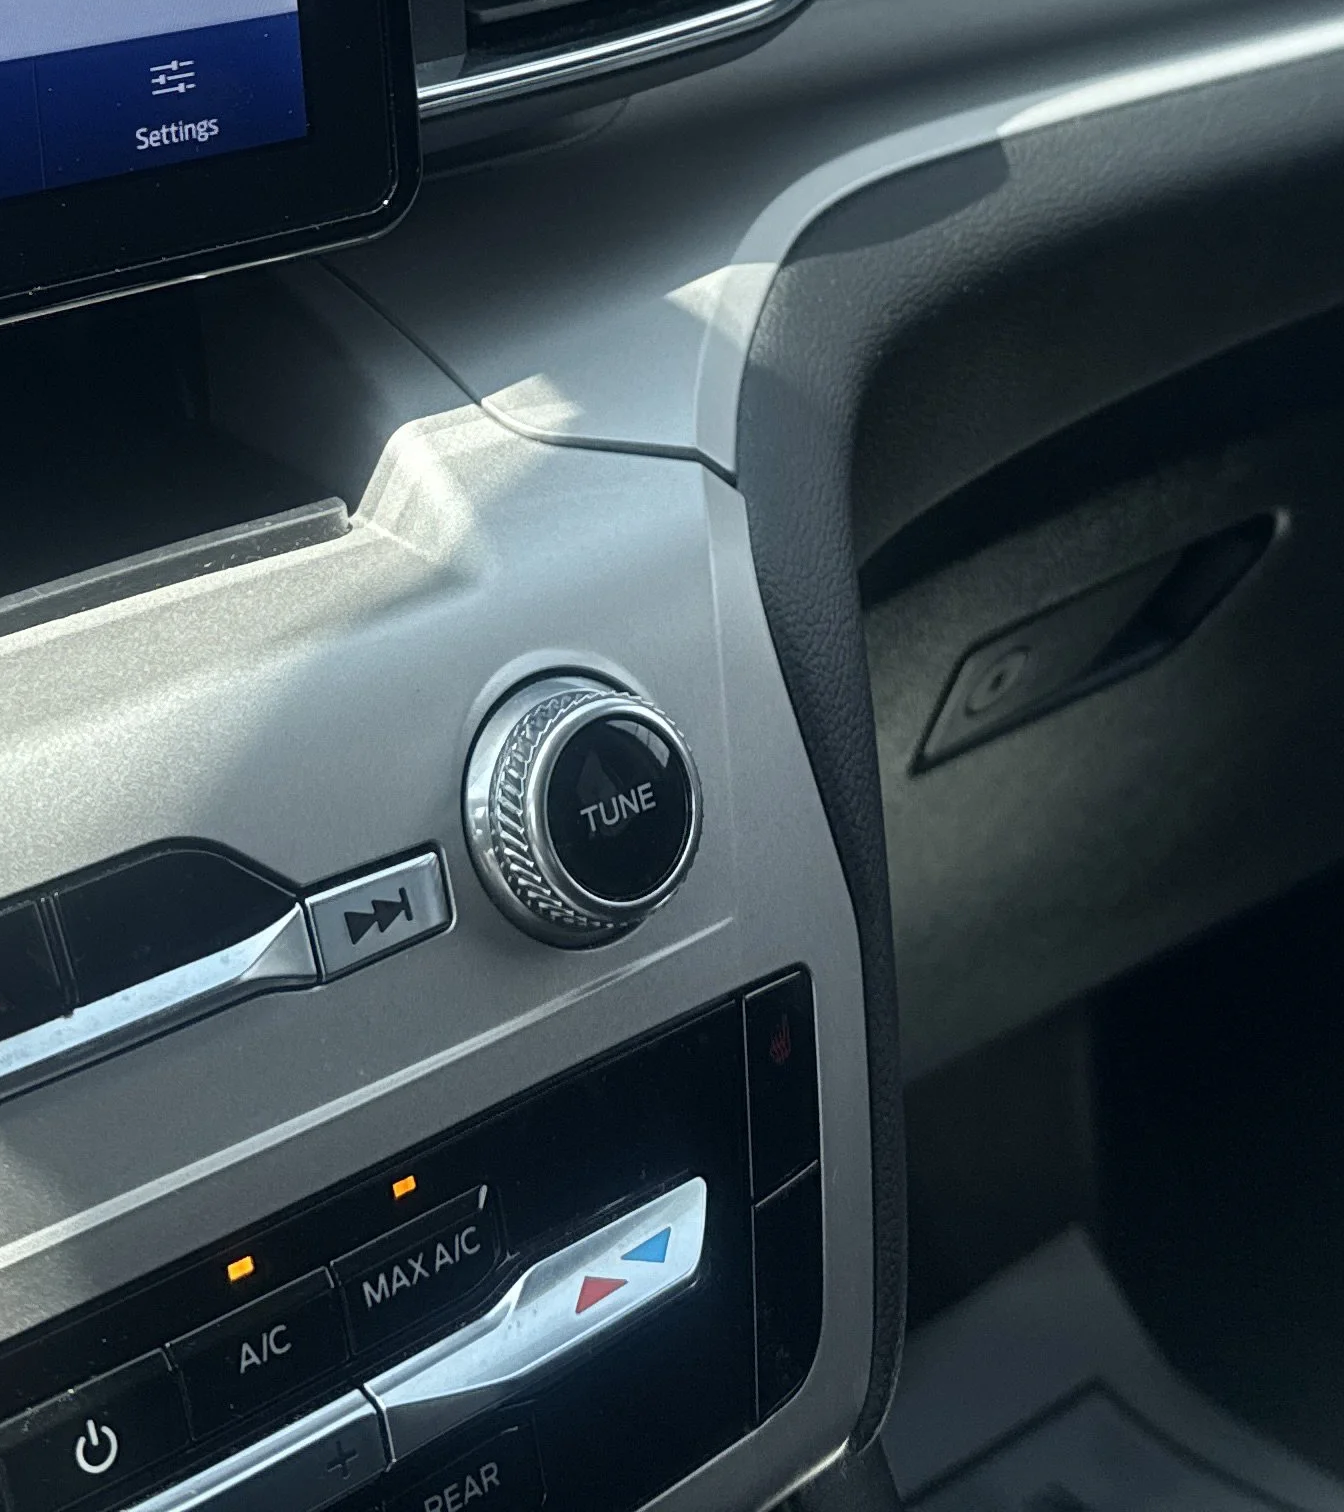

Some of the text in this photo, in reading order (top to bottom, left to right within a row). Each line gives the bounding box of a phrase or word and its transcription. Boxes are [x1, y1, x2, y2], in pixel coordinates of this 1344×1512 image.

[134, 114, 220, 152] Settings
[580, 782, 656, 832] TUNE
[362, 1226, 482, 1308] MAX A/C
[239, 1324, 292, 1374] A/C
